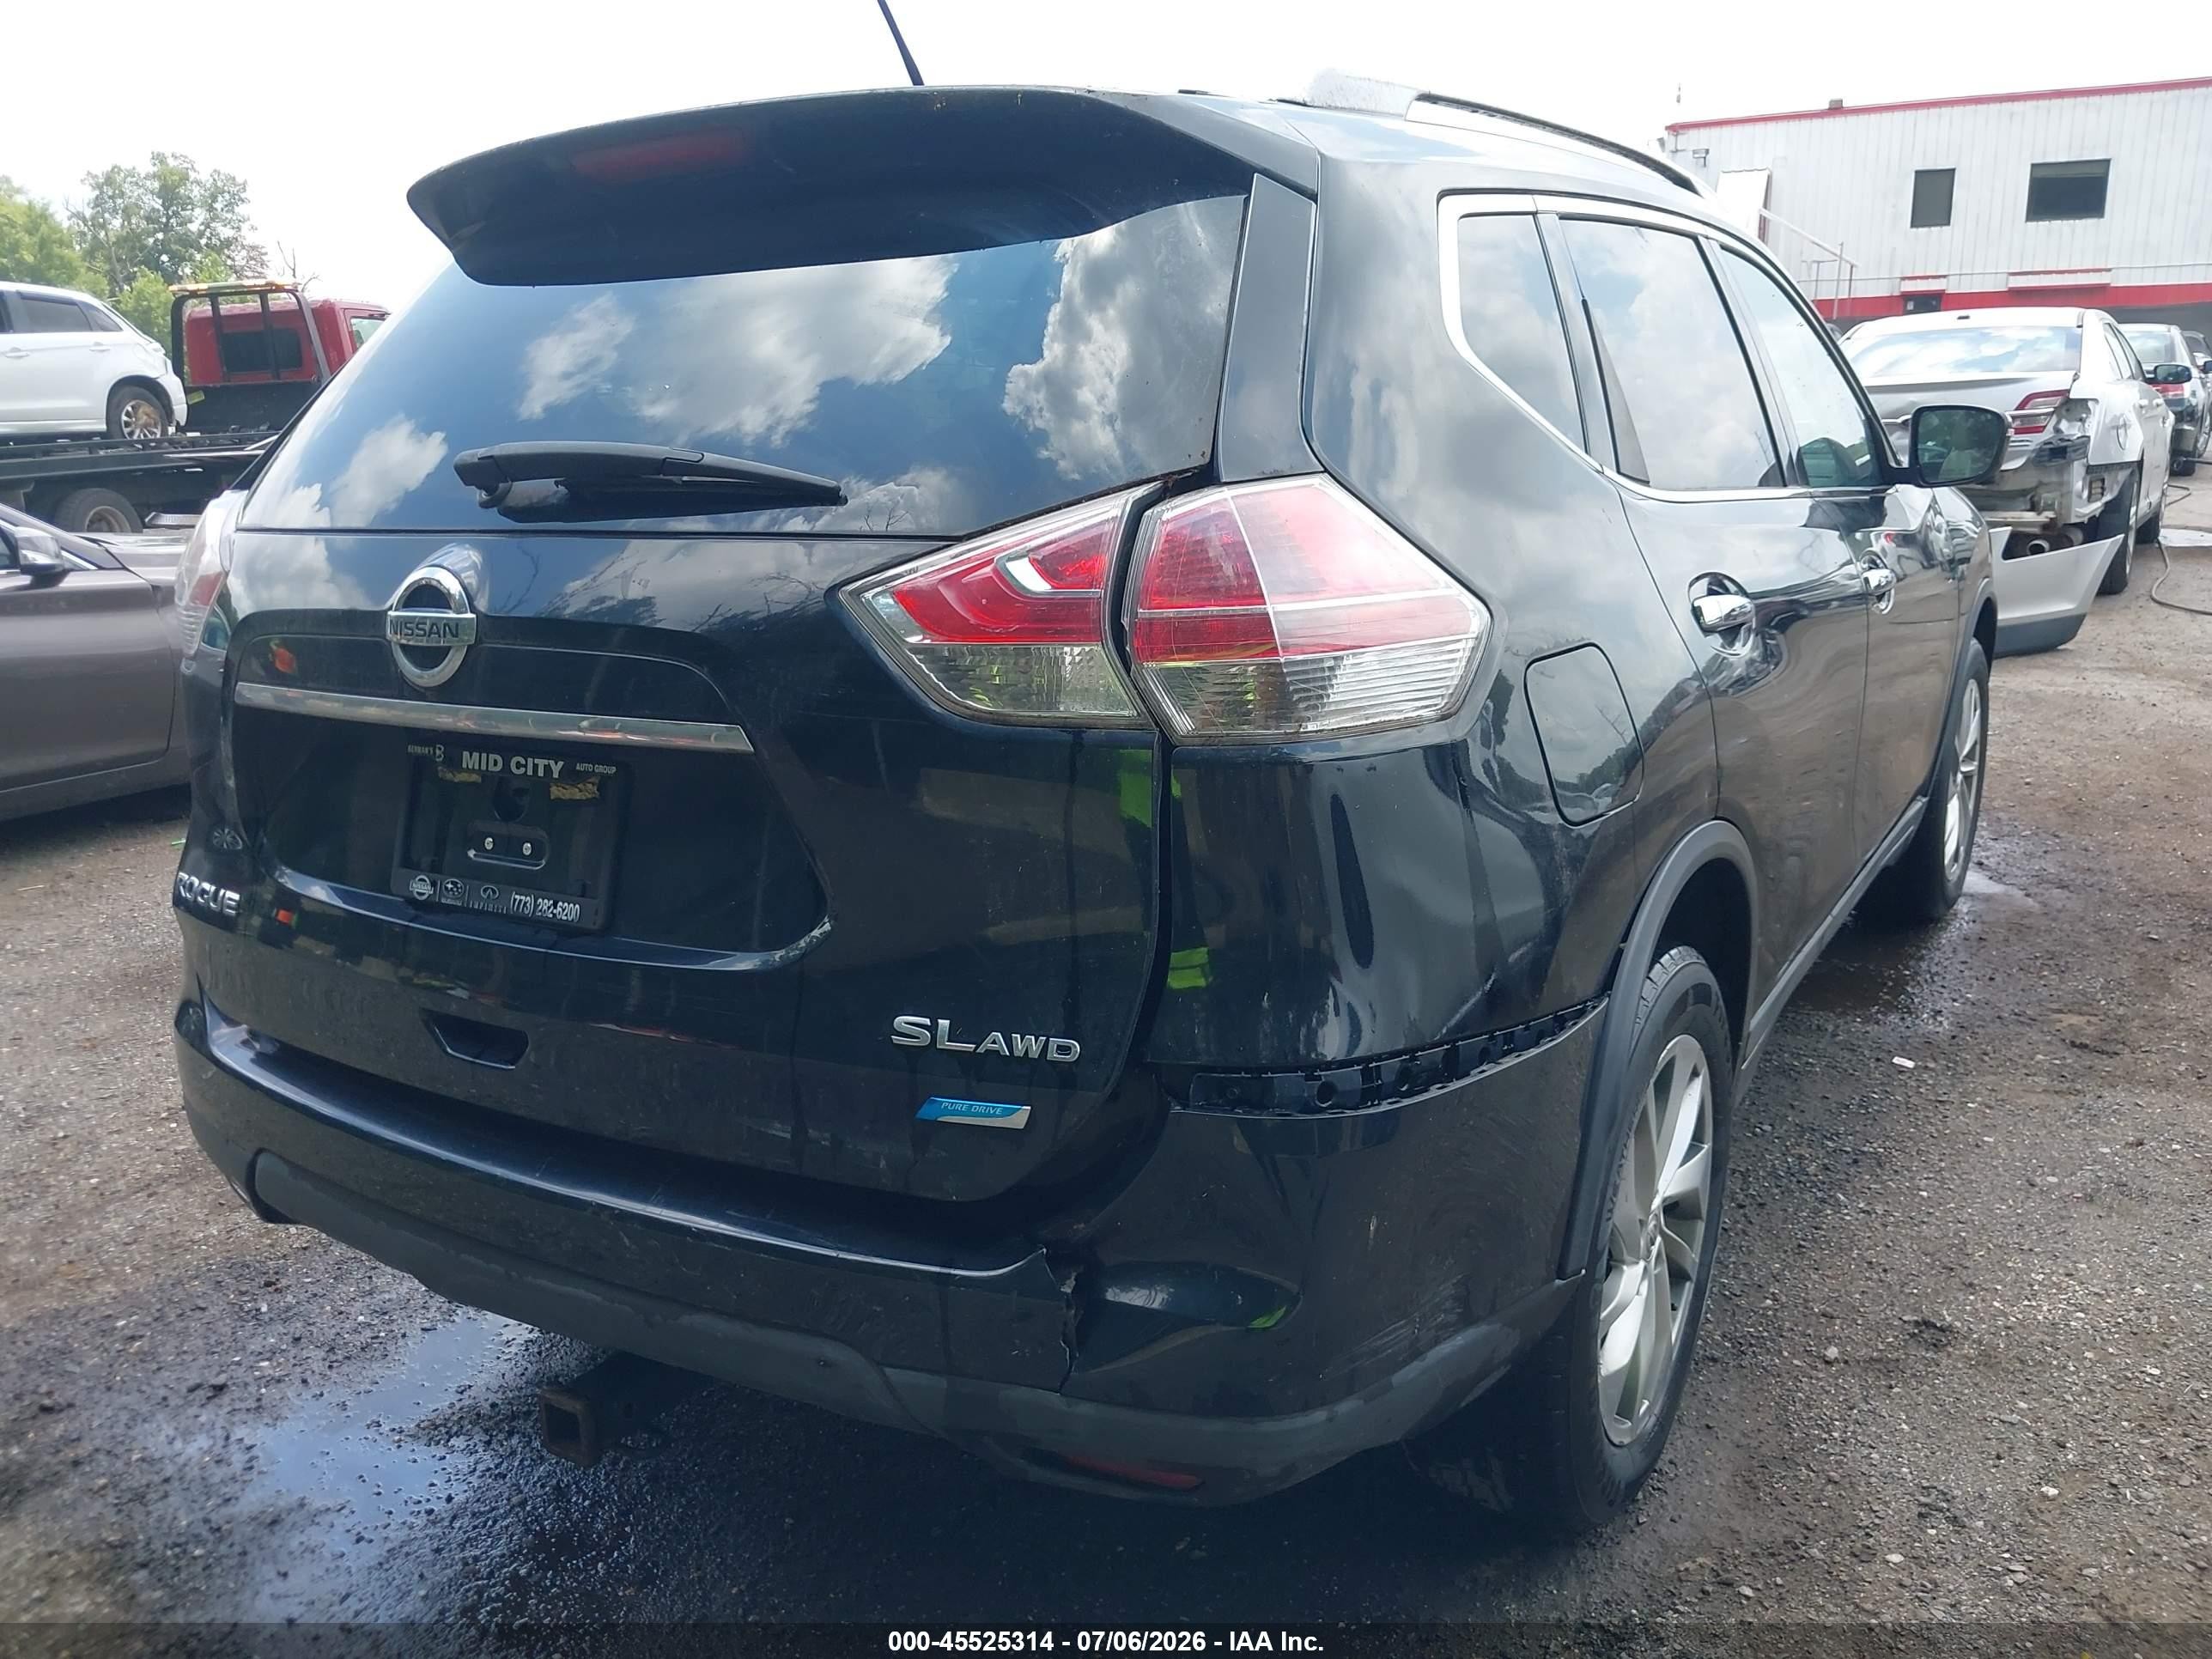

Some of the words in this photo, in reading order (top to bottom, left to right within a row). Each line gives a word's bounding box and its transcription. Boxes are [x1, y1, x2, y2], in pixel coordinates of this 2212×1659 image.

[389, 618, 459, 639] NISSAN
[462, 750, 503, 772] MID
[510, 757, 564, 778] CITY
[576, 763, 593, 771] AUTO
[594, 764, 617, 774] GROUP
[510, 891, 535, 917] (773)
[536, 897, 580, 922] 282-6200
[941, 1102, 969, 1112] PURE
[971, 1105, 1003, 1115] DRIVE
